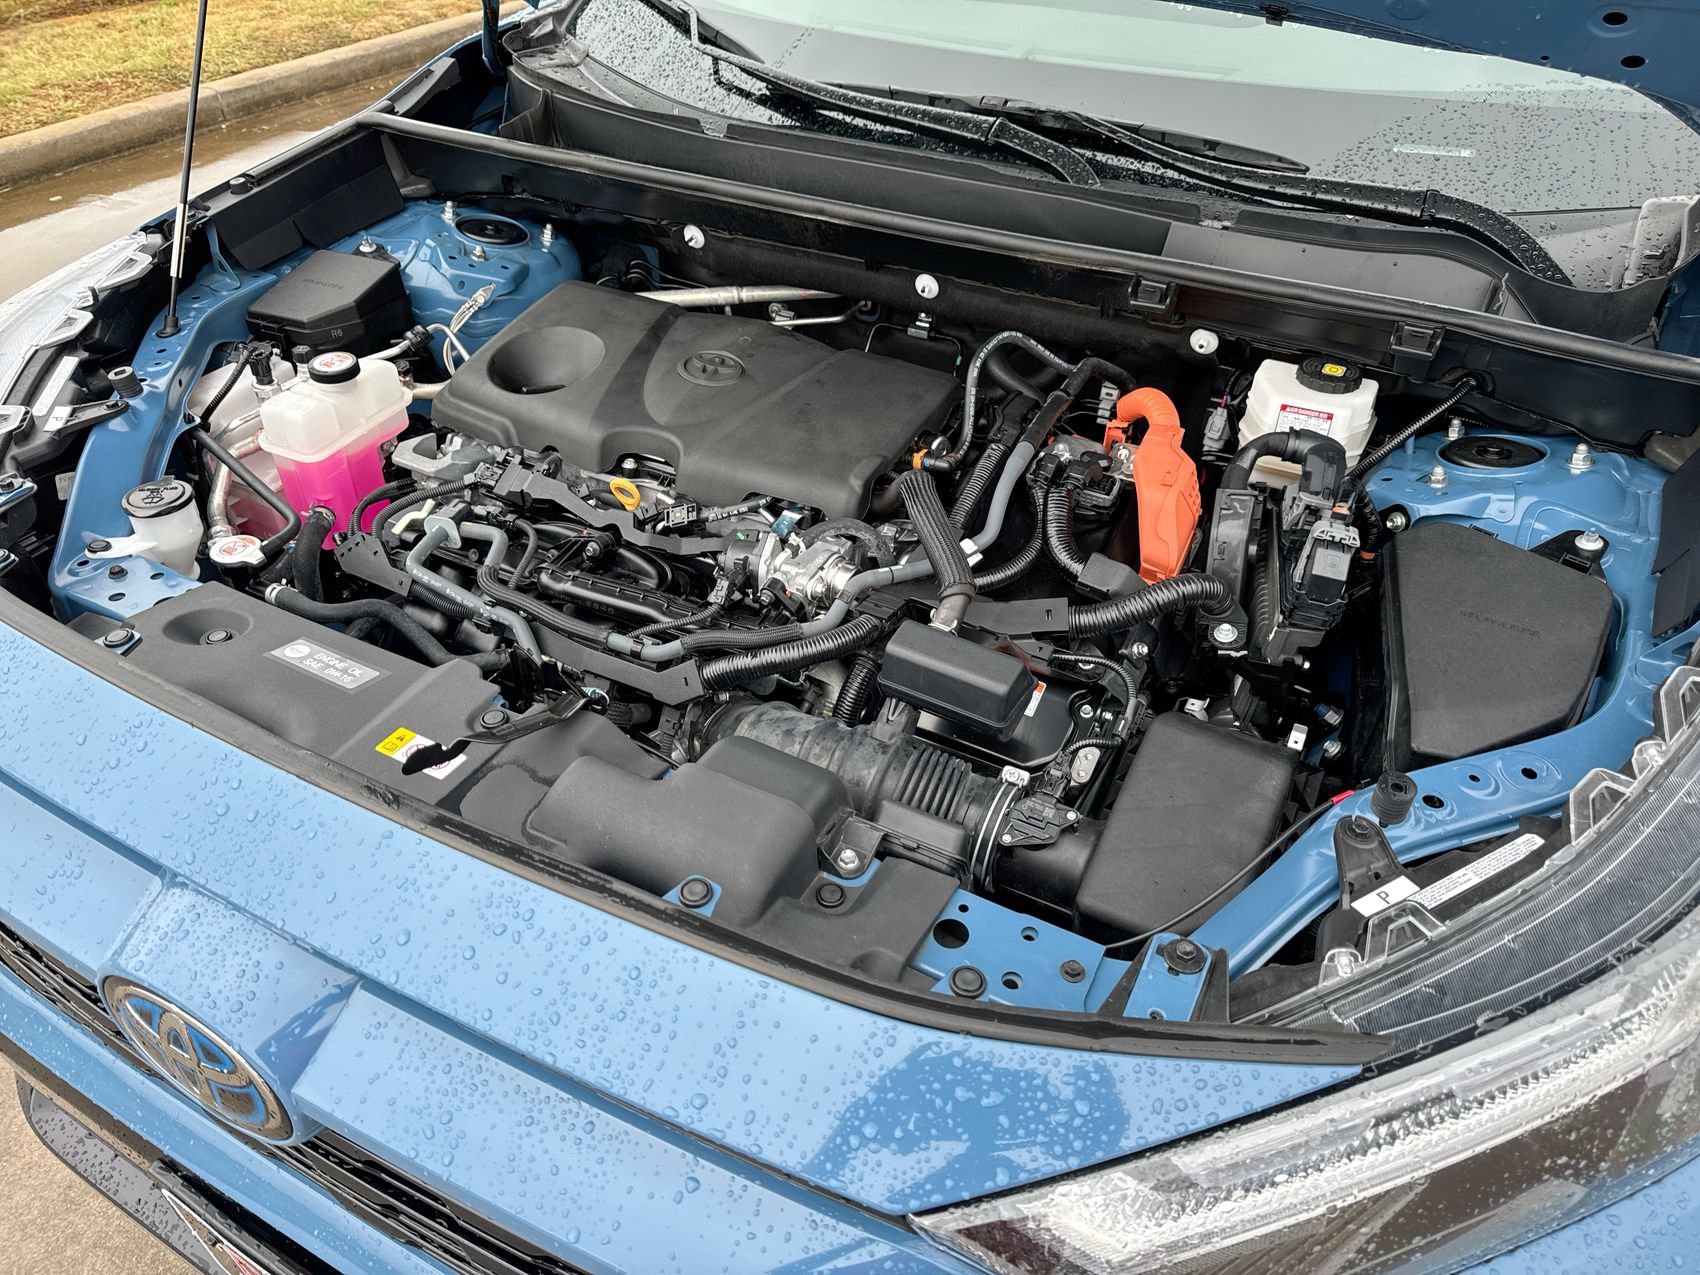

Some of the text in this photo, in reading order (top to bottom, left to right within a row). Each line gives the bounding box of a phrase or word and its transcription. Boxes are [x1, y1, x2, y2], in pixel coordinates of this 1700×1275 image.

[330, 328, 343, 339] R6
[302, 658, 325, 669] SAE
[314, 652, 363, 678] ENGINE OIL
[1376, 890, 1390, 904] P
